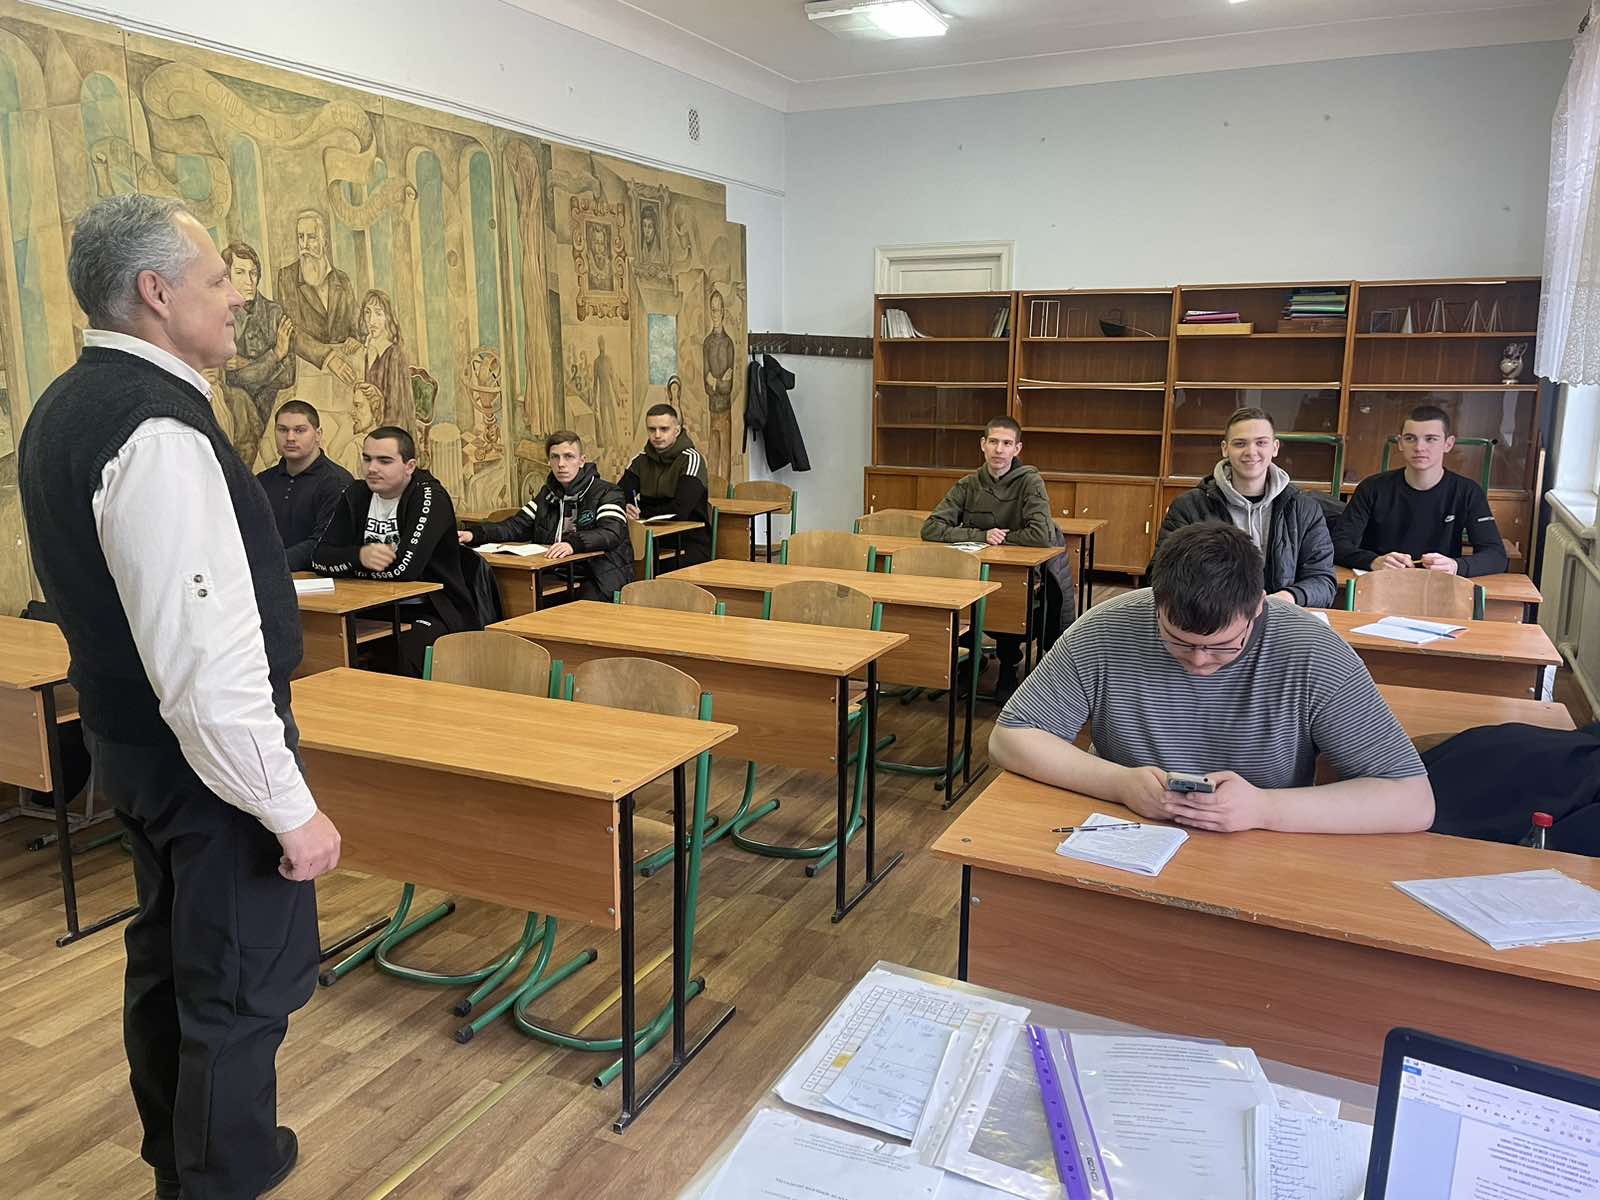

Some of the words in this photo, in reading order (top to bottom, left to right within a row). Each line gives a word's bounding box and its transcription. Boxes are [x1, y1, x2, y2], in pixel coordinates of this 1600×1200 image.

[423, 486, 432, 514] HUGO
[411, 516, 427, 545] BOSS
[393, 550, 413, 576] HUGO
